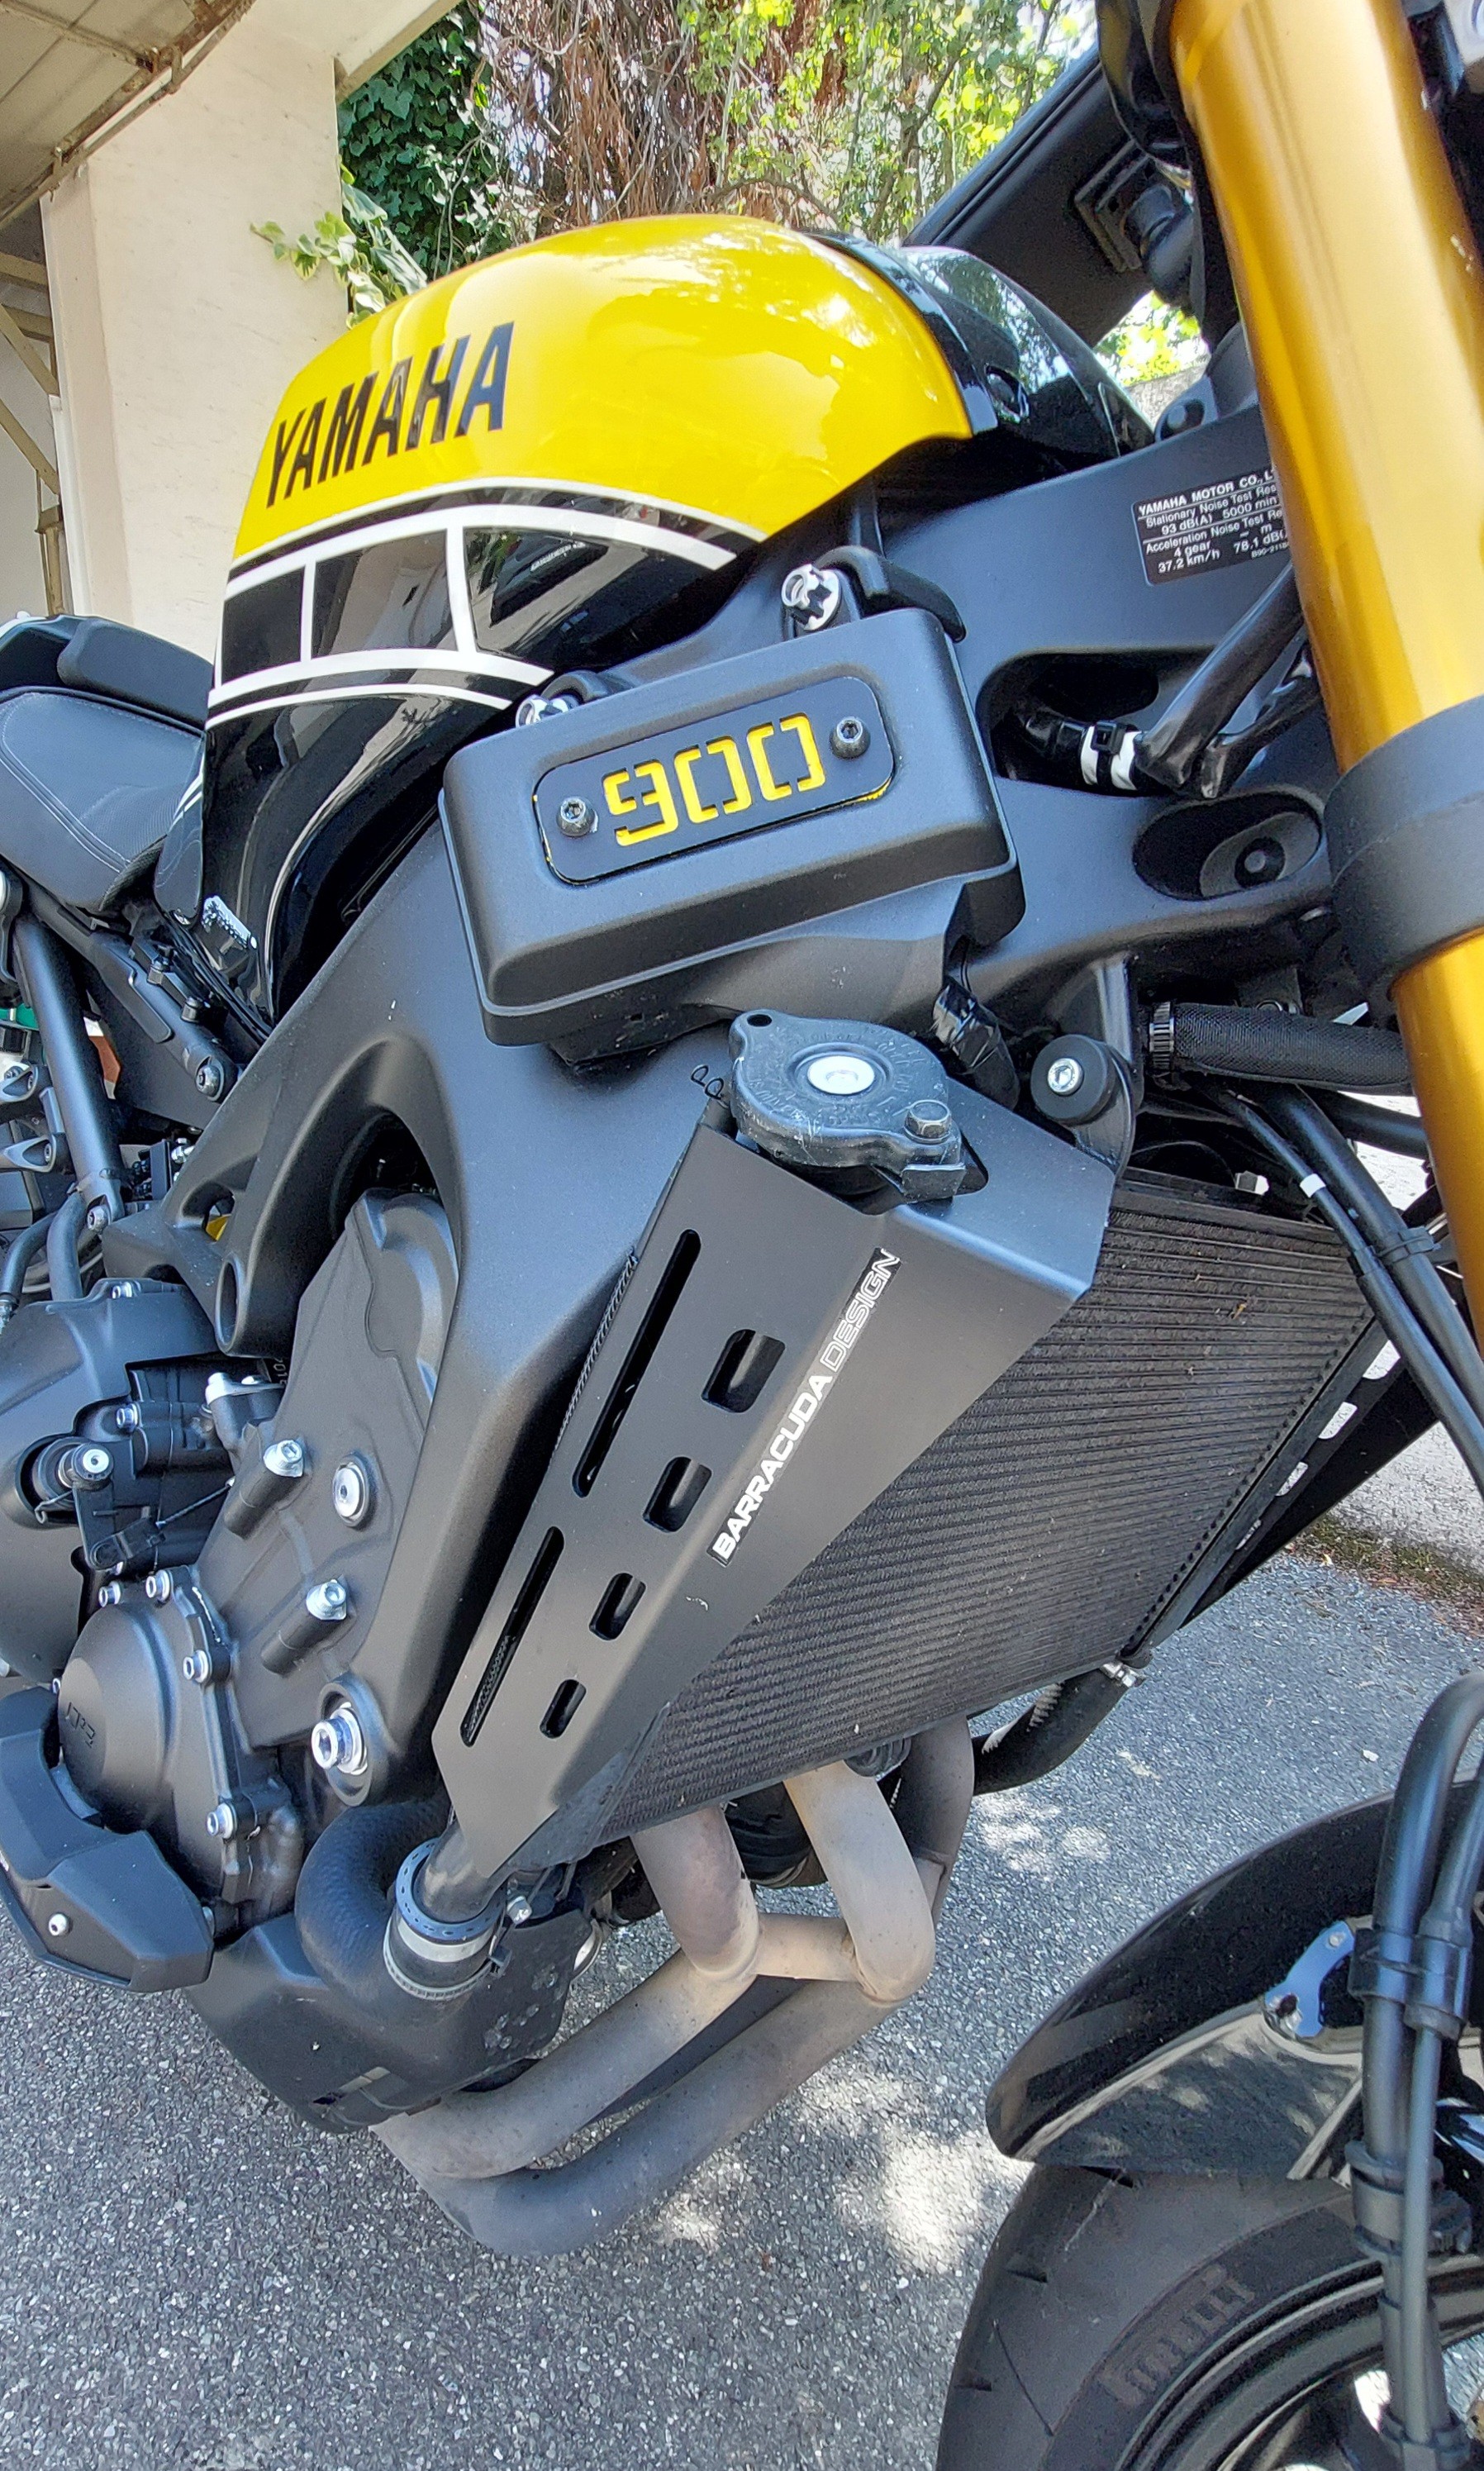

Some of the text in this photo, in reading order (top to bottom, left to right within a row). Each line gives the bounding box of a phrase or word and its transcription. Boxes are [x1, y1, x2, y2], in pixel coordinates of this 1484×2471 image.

[266, 321, 514, 508] YAMAHA
[1139, 495, 1187, 516] YAMAHA
[1191, 482, 1234, 502] MOTOR
[1146, 484, 1277, 528] Stationary Noise Test Res
[1162, 497, 1277, 536] 93 dB(A) 5000 min
[1146, 510, 1282, 555] Acceleration Noise Test Re
[1174, 547, 1182, 558] 4
[1184, 540, 1211, 556] gear
[1260, 523, 1272, 534] m
[1187, 549, 1220, 568] km/h
[1263, 529, 1287, 545] dB(
[602, 712, 825, 847] 900
[711, 1248, 901, 1559] BARRACUDA DESIGN
